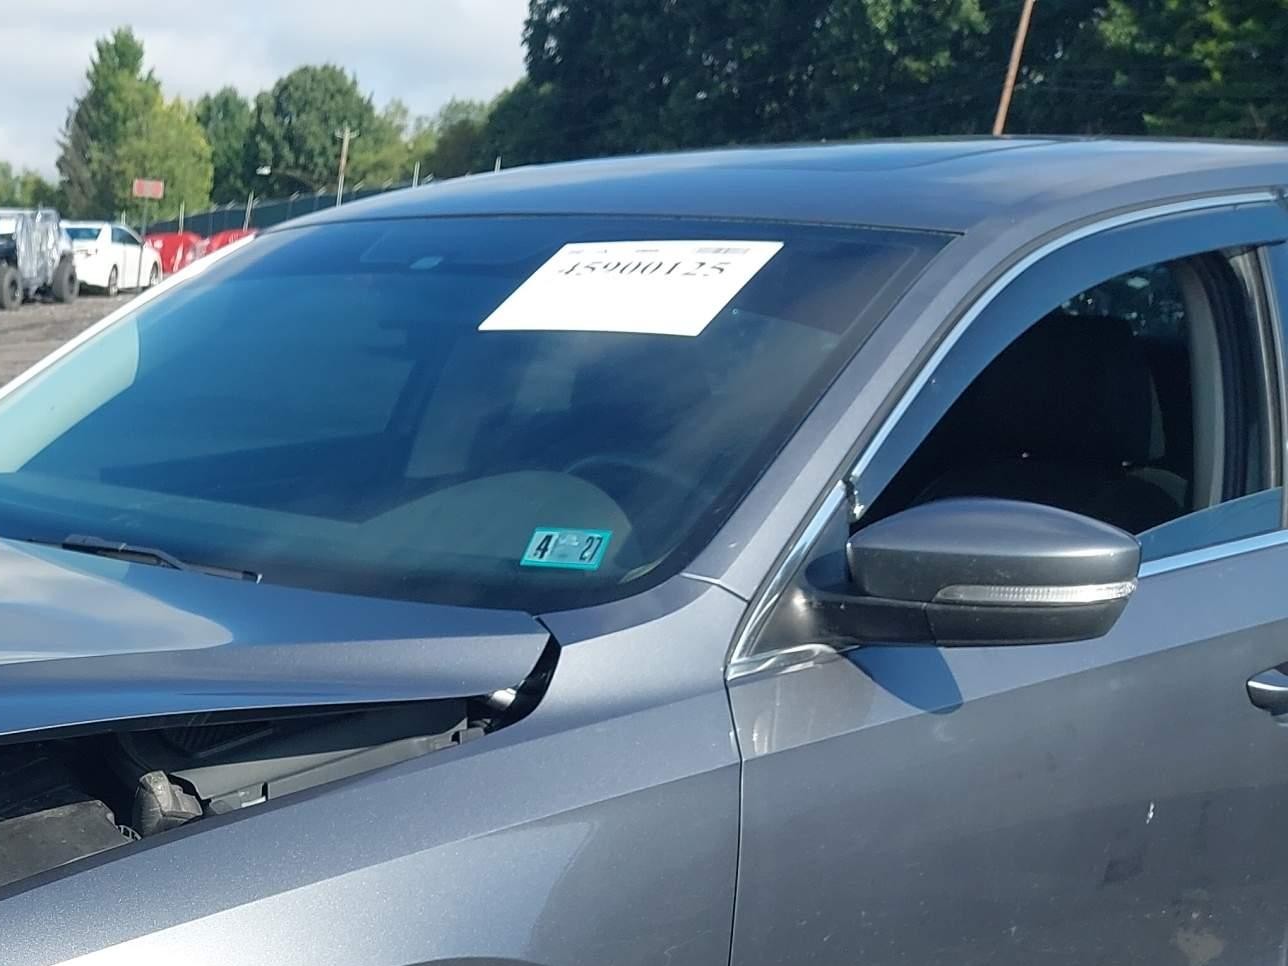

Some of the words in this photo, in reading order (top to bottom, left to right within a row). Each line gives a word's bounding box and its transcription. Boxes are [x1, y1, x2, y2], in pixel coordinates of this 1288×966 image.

[558, 261, 732, 277] 45900125
[533, 534, 553, 559] 4
[579, 535, 604, 562] 27
